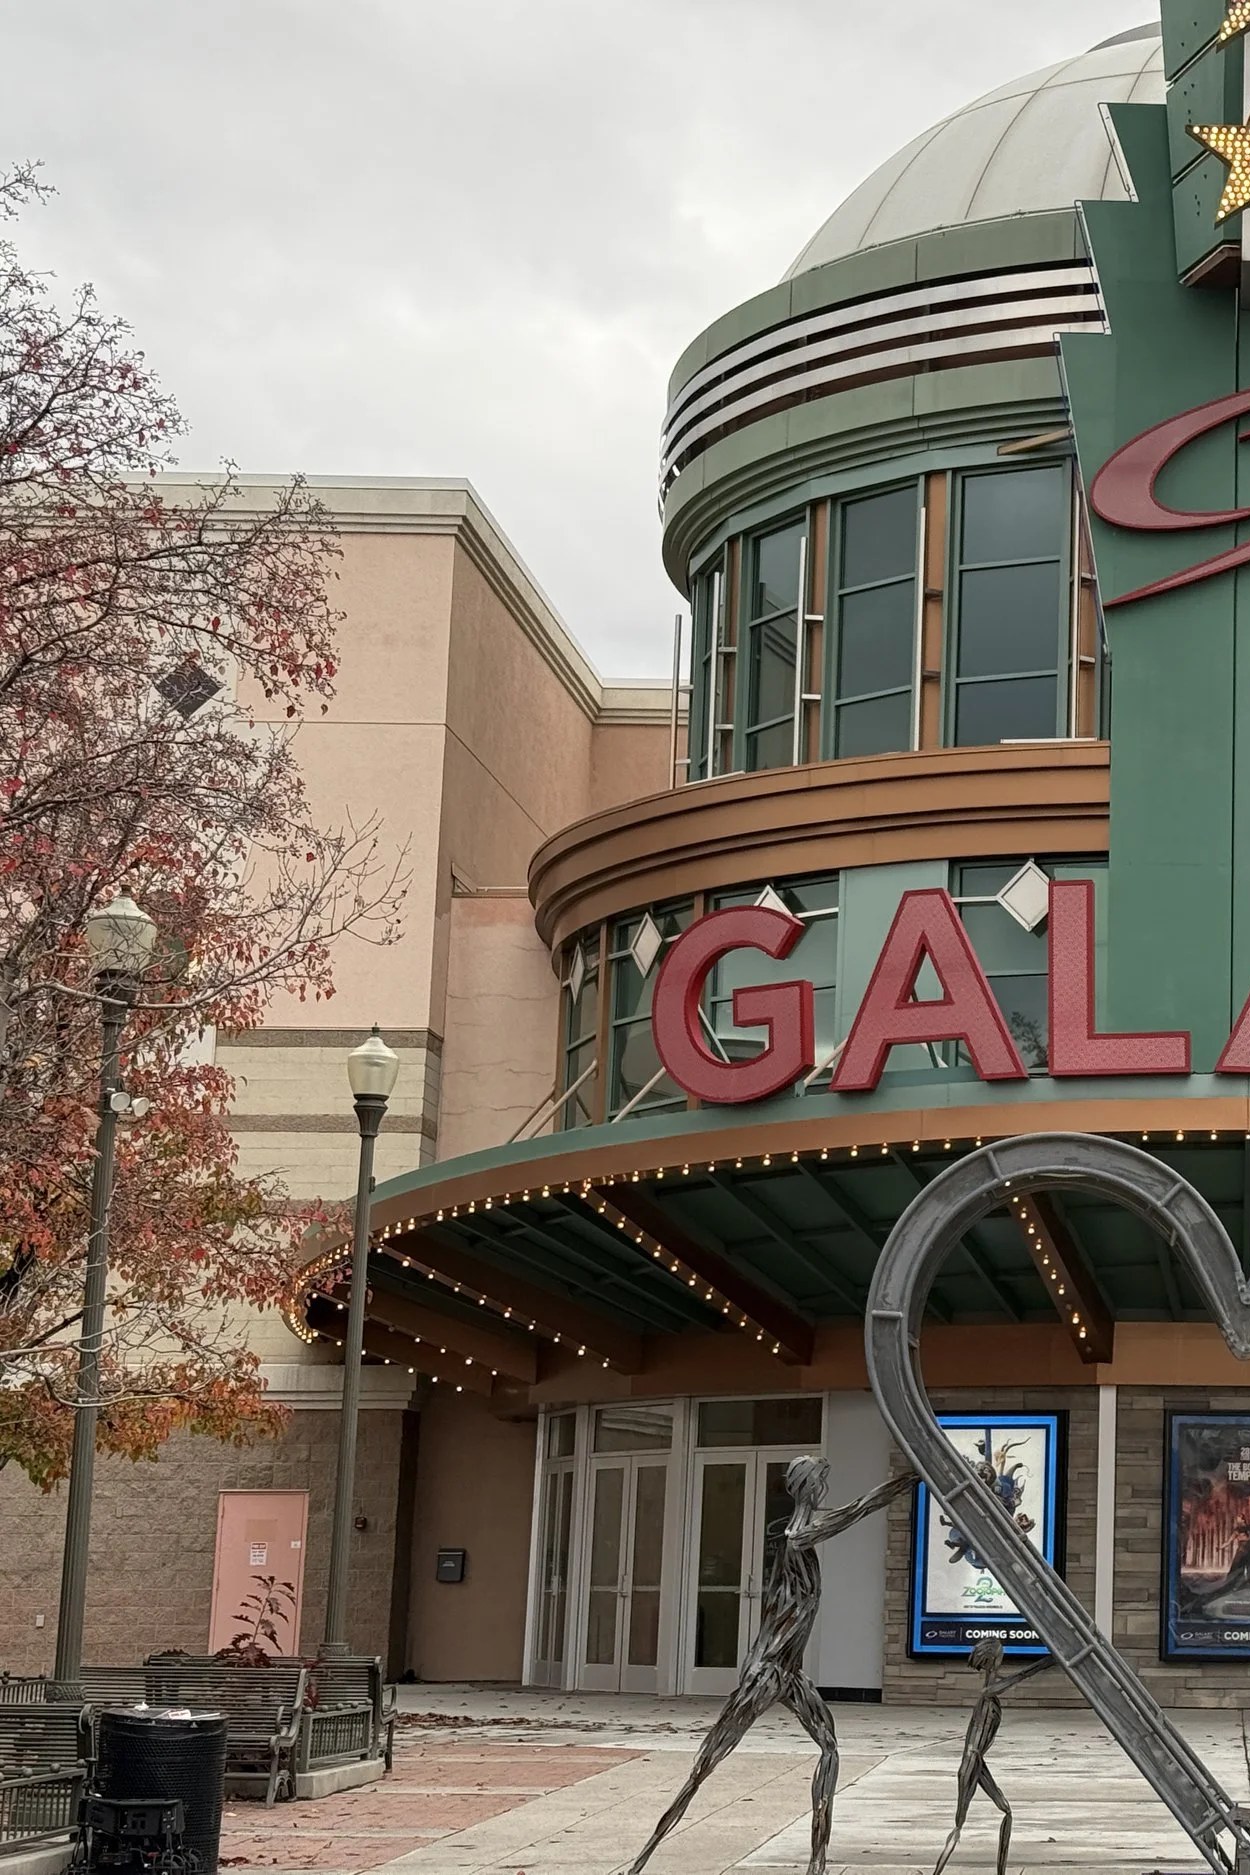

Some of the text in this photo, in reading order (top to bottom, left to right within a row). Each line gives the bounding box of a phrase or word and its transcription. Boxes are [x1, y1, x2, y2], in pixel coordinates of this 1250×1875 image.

[1228, 1463, 1241, 1471] THE
[965, 1630, 1007, 1639] COMING
[1009, 1630, 1040, 1639] SOON
